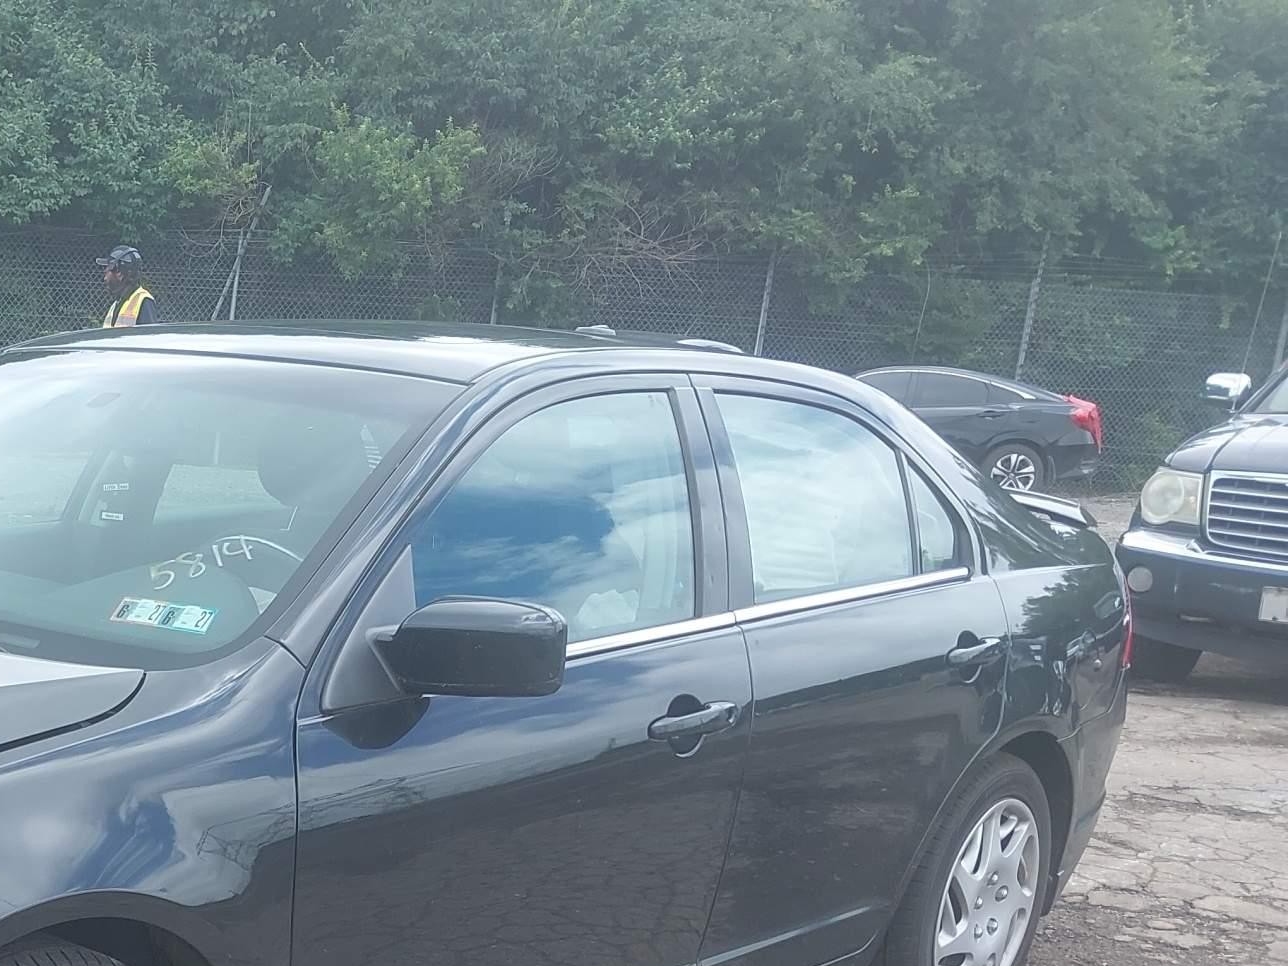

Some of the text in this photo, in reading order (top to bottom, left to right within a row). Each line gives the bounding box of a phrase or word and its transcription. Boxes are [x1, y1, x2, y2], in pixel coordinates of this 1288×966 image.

[150, 534, 253, 590] 5814
[116, 604, 167, 624] 6 27
[162, 610, 214, 630] 6 27
